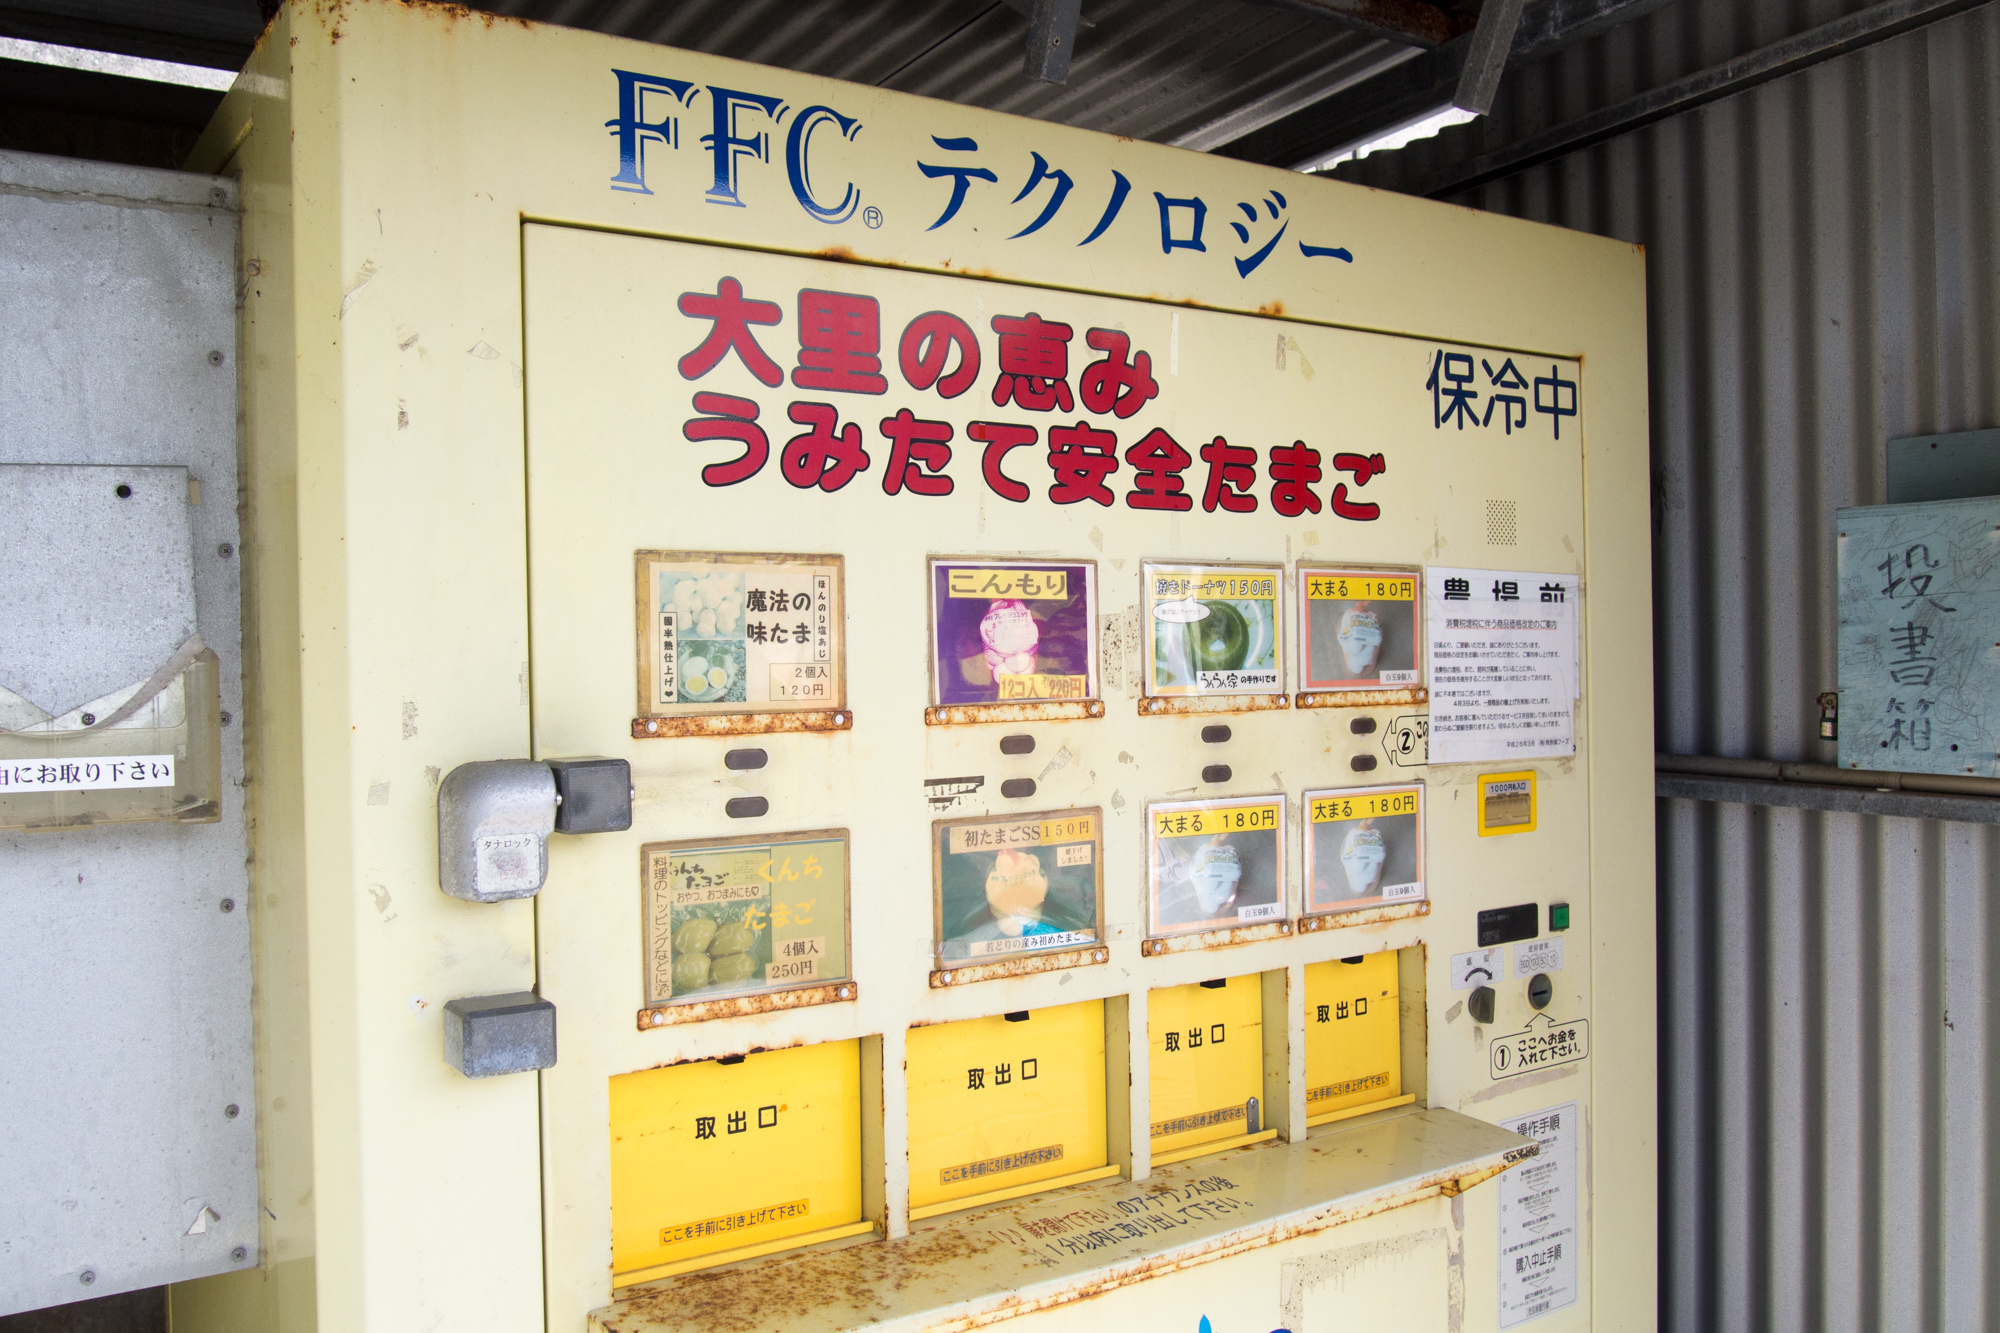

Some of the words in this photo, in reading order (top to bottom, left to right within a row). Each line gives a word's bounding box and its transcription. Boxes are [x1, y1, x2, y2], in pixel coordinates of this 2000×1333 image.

[916, 133, 1354, 279] テクノロジー
[677, 275, 1160, 419] 大里の恵み
[1425, 348, 1578, 440] 保冷中
[682, 391, 1387, 522] うみたて安全たまご
[951, 573, 1066, 596] こんもり
[1310, 579, 1348, 597] 大まる
[1365, 581, 1412, 598] 180円
[746, 588, 812, 613] 魔法の
[746, 621, 812, 646] 味たま
[1877, 543, 1957, 751] 投書箱
[779, 684, 824, 696] 120円
[1050, 677, 1082, 698] 220円
[1314, 800, 1353, 820] 大まる
[1369, 795, 1415, 813] 180円
[964, 824, 1041, 848] 初たまごSS
[1044, 820, 1090, 838] 150円
[1159, 814, 1203, 834] 大まる
[1223, 809, 1274, 828] 180円
[483, 837, 532, 851] タナロック
[758, 854, 823, 884] くんち
[743, 897, 817, 931] たまご
[782, 939, 819, 957] 4個入
[985, 931, 1082, 953] 若どりの産み初めたまご
[771, 959, 813, 979] 250円
[1316, 996, 1368, 1024] 取出口
[1165, 1023, 1225, 1053] 取出口
[1517, 1028, 1577, 1053] ここへお金を
[1517, 1041, 1582, 1068] 入れて下さい。
[967, 1058, 1038, 1091] 取出口
[695, 1105, 778, 1140] 取出口
[943, 1148, 1062, 1183] ここを手前に引き上げて下さい
[662, 1202, 807, 1244] ここを手前に引き上げて下さい
